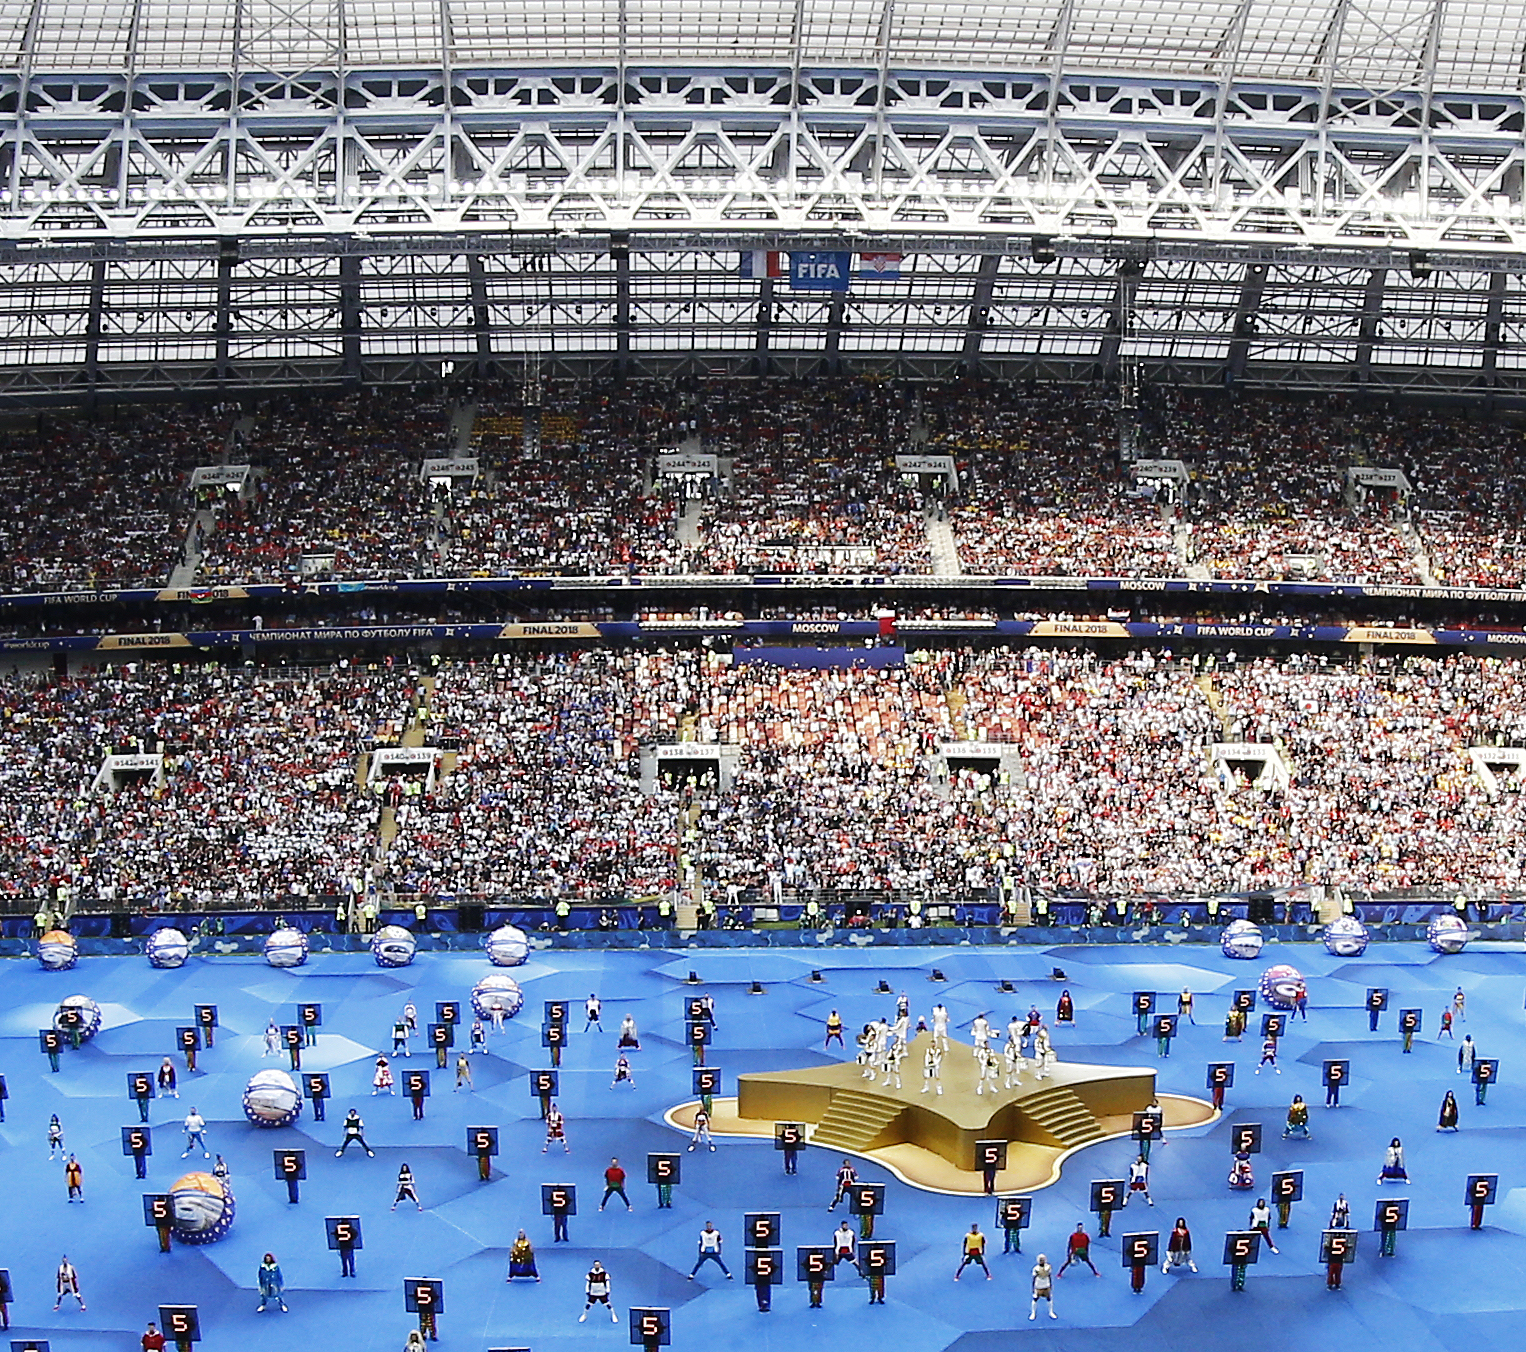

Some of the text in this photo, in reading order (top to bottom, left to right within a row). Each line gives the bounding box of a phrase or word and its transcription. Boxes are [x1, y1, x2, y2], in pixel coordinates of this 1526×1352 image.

[797, 263, 841, 279] FIFA
[1120, 582, 1165, 590] MOSCOW
[44, 594, 118, 605] FIFA WORLD CUP
[1363, 587, 1421, 598] ЧЕМПИОНАТ
[1450, 591, 1464, 599] ПО
[249, 628, 433, 641] ЧЕМПИОНАТ МИРА ПО ФУТБОЛУ FIFA
[523, 626, 578, 635] FINAL 2018
[792, 623, 839, 633] MOSCOW
[1054, 625, 1107, 634] FINAL 2018
[1197, 626, 1275, 637] FIFA WORLD CUP
[118, 637, 171, 646] FINAL 2018
[1367, 631, 1416, 640] FINAL 2018
[1140, 996, 1149, 1008] 5
[549, 1028, 559, 1040] 5
[694, 1027, 704, 1039] 5
[1331, 1066, 1341, 1079] 5
[1480, 1065, 1491, 1077] 5
[136, 1078, 147, 1092] 5
[411, 1076, 421, 1090] 5
[1476, 1182, 1488, 1197] 5
[553, 1192, 565, 1206] 5
[861, 1191, 874, 1206] 5
[1007, 1205, 1021, 1220] 5
[337, 1225, 351, 1240] 5
[1134, 1241, 1148, 1257] 5
[1332, 1238, 1346, 1254] 5
[758, 1258, 771, 1275] 5
[172, 1315, 187, 1331] 5
[643, 1317, 657, 1335] 5
